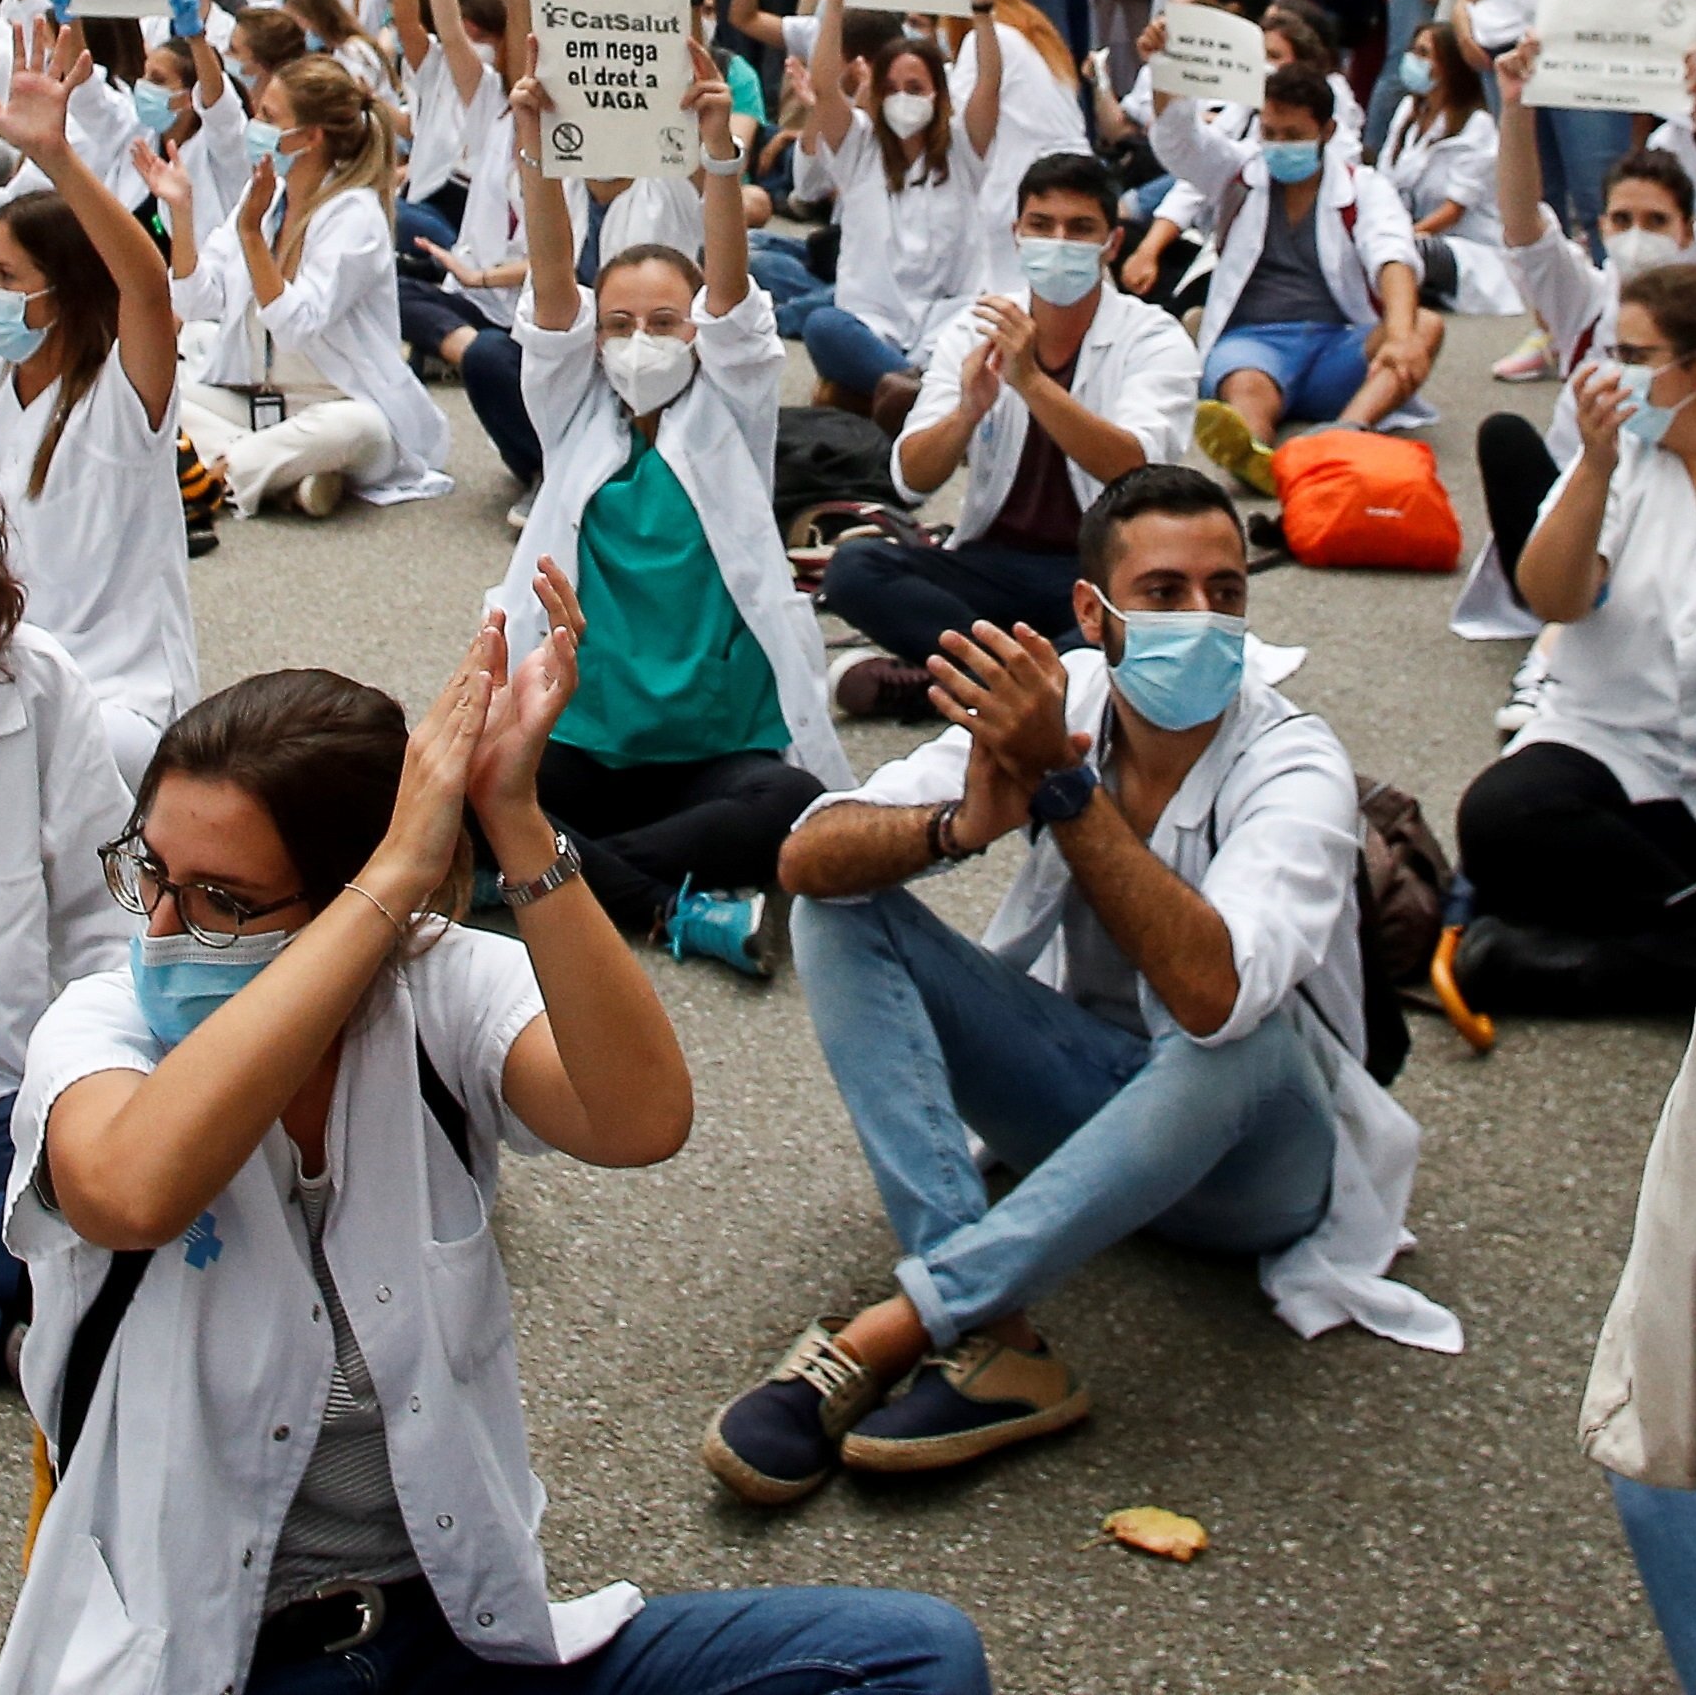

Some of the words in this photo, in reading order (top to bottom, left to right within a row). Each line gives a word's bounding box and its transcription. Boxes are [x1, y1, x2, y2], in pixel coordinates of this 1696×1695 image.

[570, 9, 681, 35] CatSalut
[566, 40, 598, 59] em
[606, 42, 658, 67] nega
[568, 66, 587, 86] el
[594, 67, 638, 89] dret
[646, 74, 659, 89] a
[584, 91, 650, 111] VAGA
